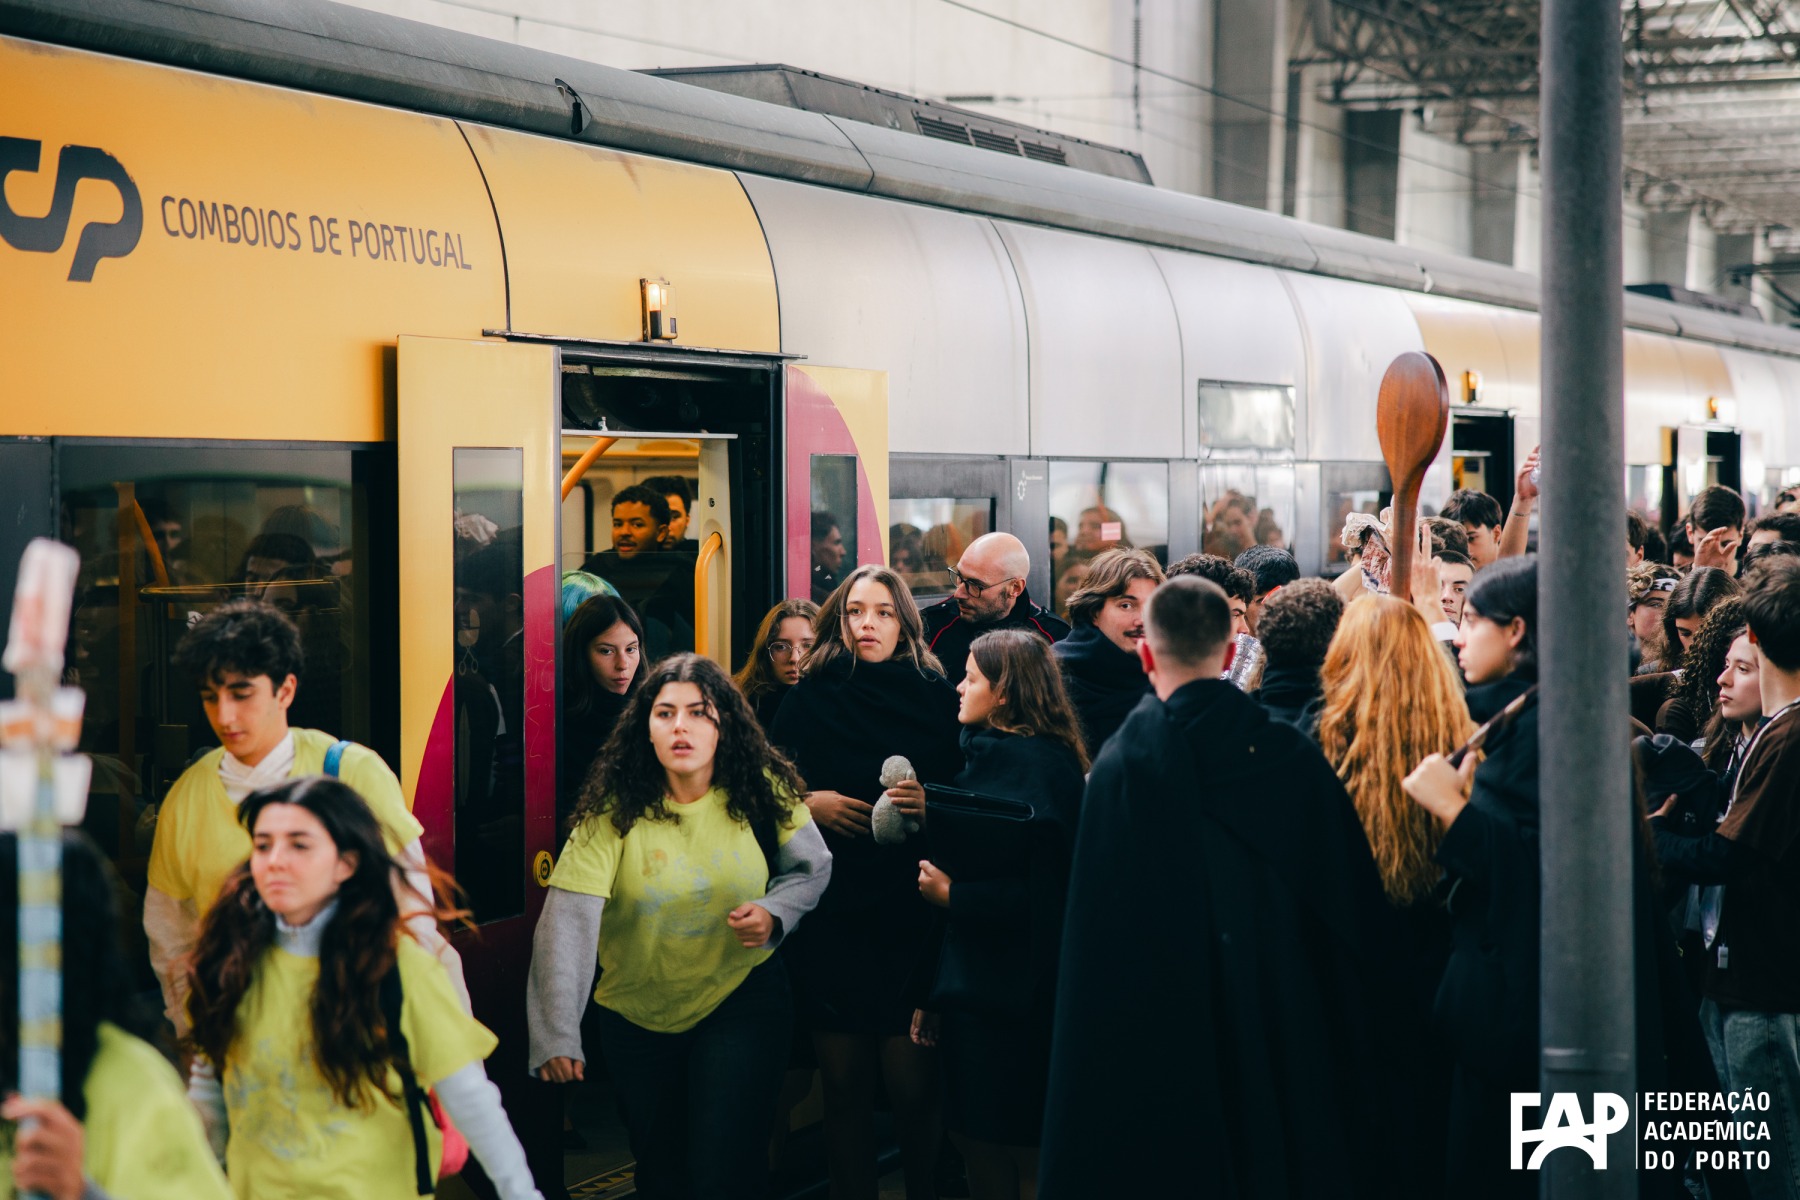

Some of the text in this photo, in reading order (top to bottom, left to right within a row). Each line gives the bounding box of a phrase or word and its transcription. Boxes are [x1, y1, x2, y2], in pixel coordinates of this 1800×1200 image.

[161, 195, 472, 270] COMBOIOS DE PORTUGAL
